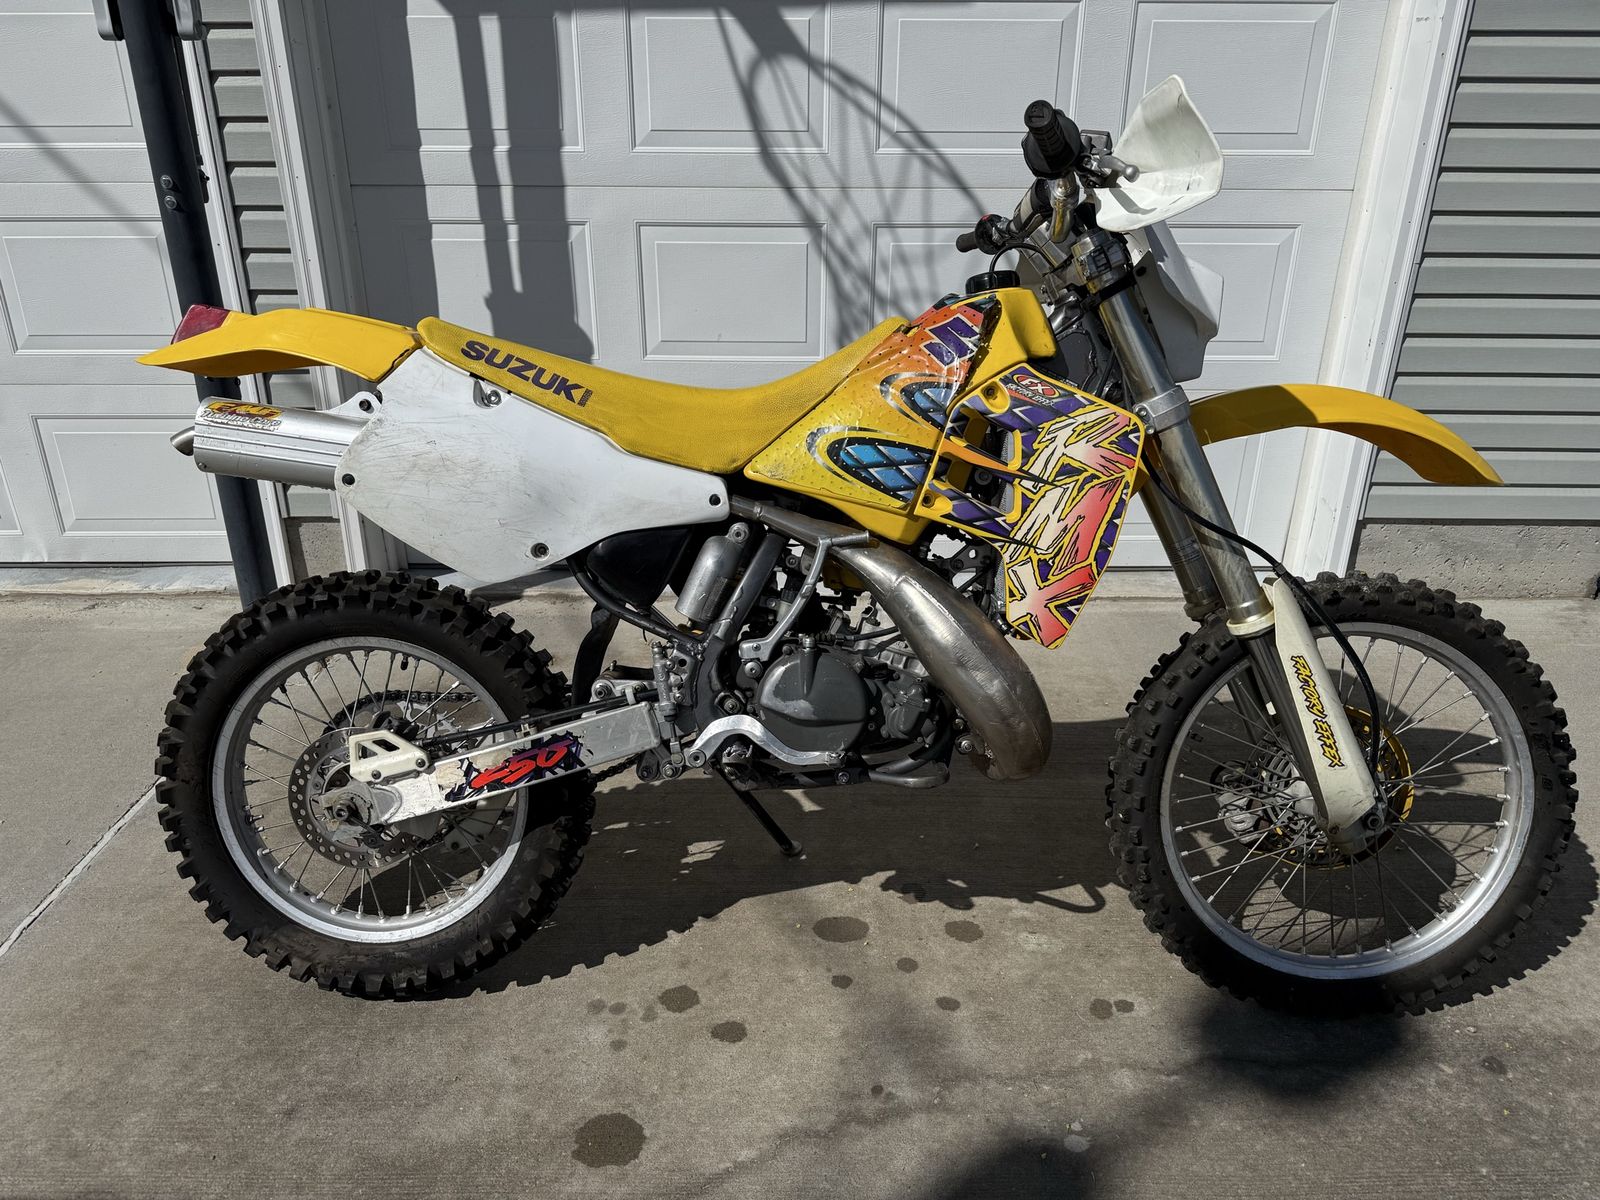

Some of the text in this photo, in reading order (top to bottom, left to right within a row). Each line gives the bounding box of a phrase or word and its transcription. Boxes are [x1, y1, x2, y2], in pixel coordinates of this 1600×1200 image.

[461, 340, 593, 407] SUZUKI
[1291, 656, 1345, 768] FACTORY EFFEX
[470, 740, 574, 789] 250
